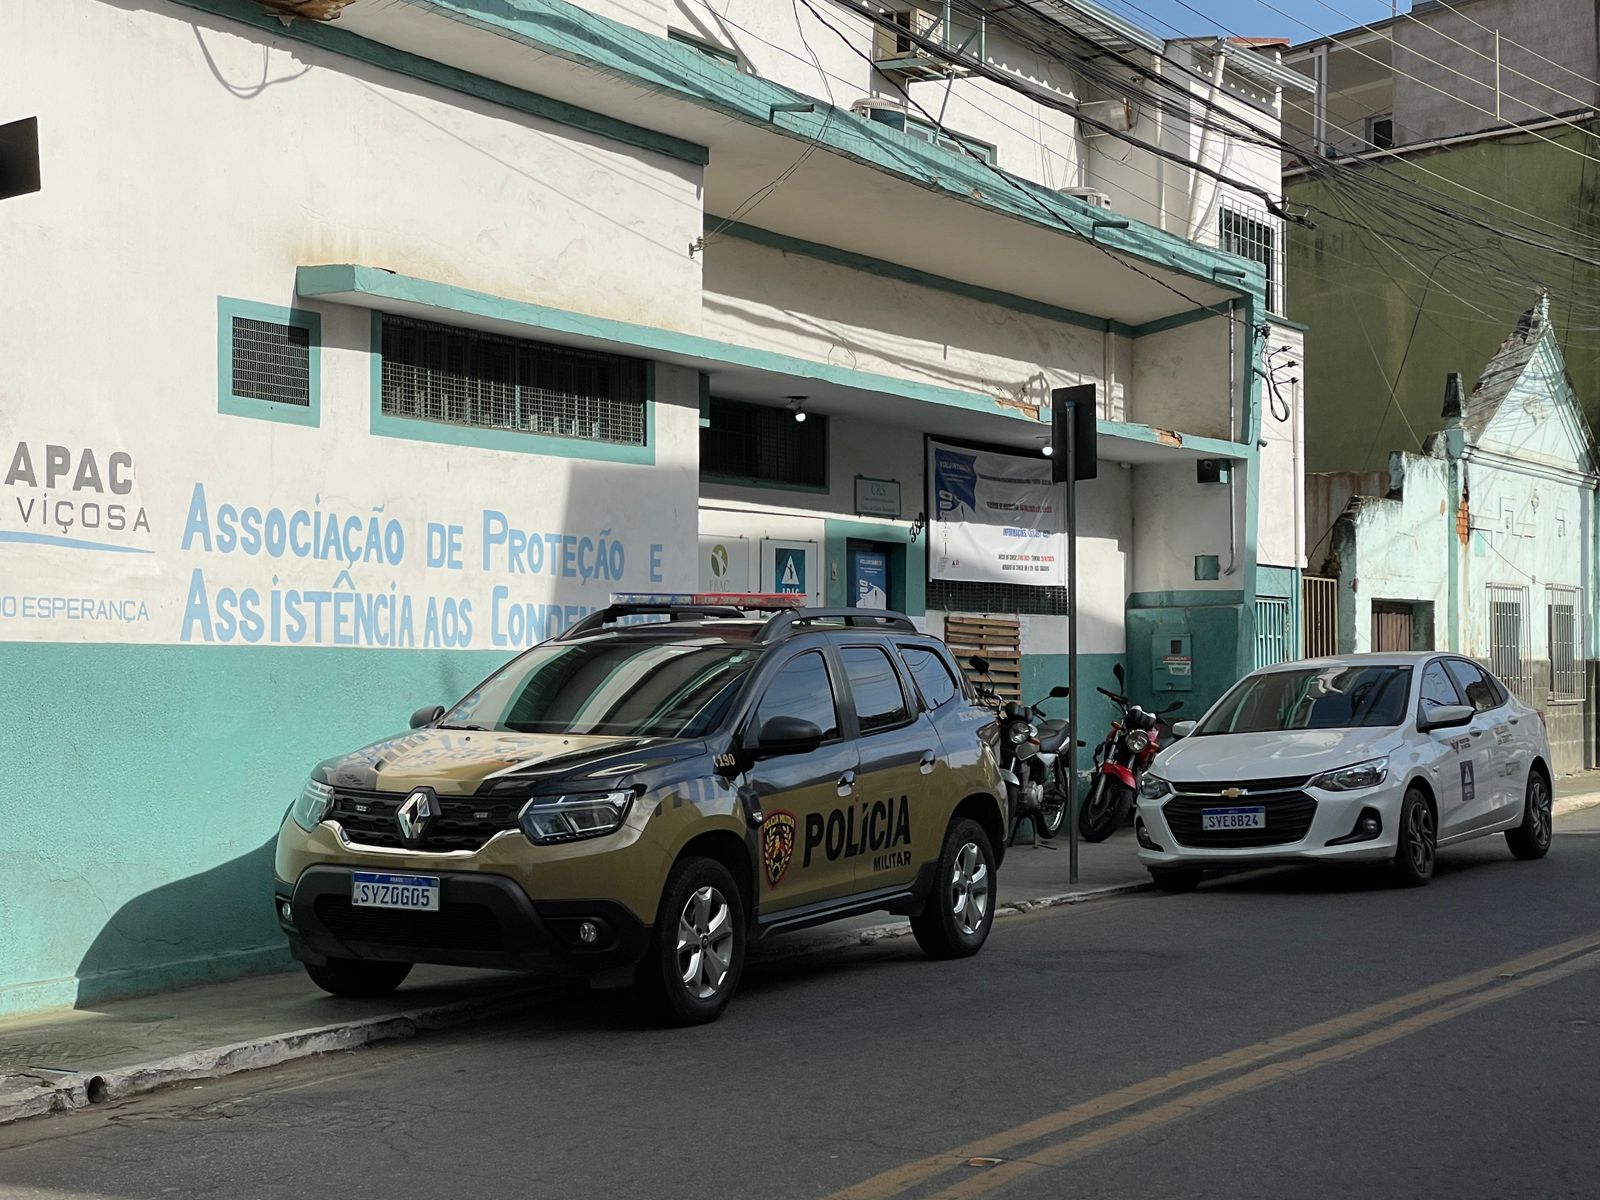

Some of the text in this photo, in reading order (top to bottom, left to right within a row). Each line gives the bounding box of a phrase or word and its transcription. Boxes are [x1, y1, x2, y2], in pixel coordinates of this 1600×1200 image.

[4, 441, 133, 495] APAC
[426, 522, 464, 570] DE
[482, 509, 625, 586] PROTEÇÃO
[650, 543, 663, 582] E
[22, 597, 149, 622] ESPERANÇA
[423, 597, 473, 648] AOS
[717, 753, 736, 767] 190
[803, 795, 911, 868] POLÍCIA
[1209, 814, 1259, 828] SYE8B24
[873, 851, 911, 873] MILITAR
[360, 884, 430, 907] SYZ0G05
